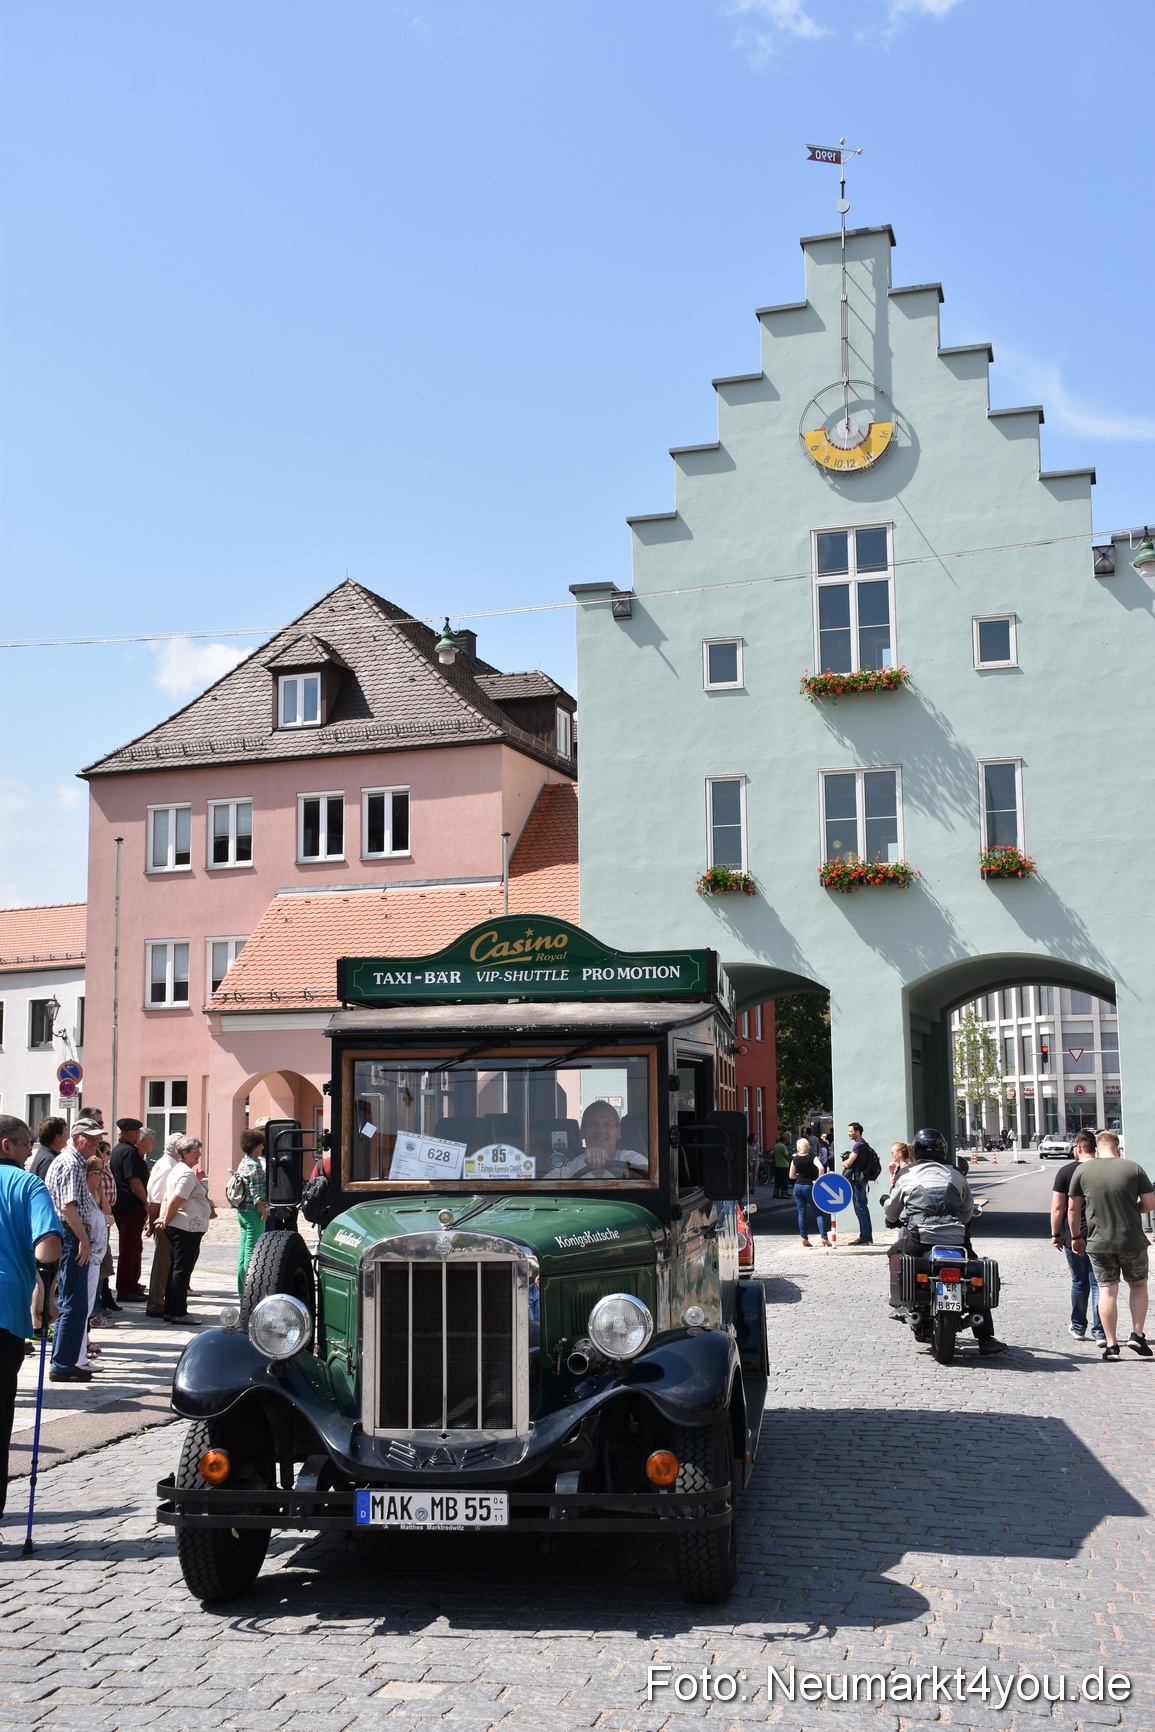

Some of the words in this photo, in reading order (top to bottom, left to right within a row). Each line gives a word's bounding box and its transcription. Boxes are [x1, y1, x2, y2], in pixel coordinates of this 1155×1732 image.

[823, 455, 831, 464] 8
[846, 459, 856, 468] 12
[862, 452, 873, 462] 14
[880, 429, 889, 439] 16
[470, 930, 568, 963] Casino
[535, 951, 568, 964] Royal
[476, 969, 569, 983] VIP-SHUTTLE
[427, 1148, 451, 1162] 628
[491, 1149, 507, 1163] 85
[946, 1284, 957, 1292] ER
[945, 1302, 961, 1310] 875
[493, 1497, 504, 1505] 04
[360, 1511, 367, 1519] D
[371, 1495, 413, 1521] MAK
[430, 1496, 458, 1521] MB
[464, 1497, 491, 1522] 55
[494, 1514, 504, 1522] 11
